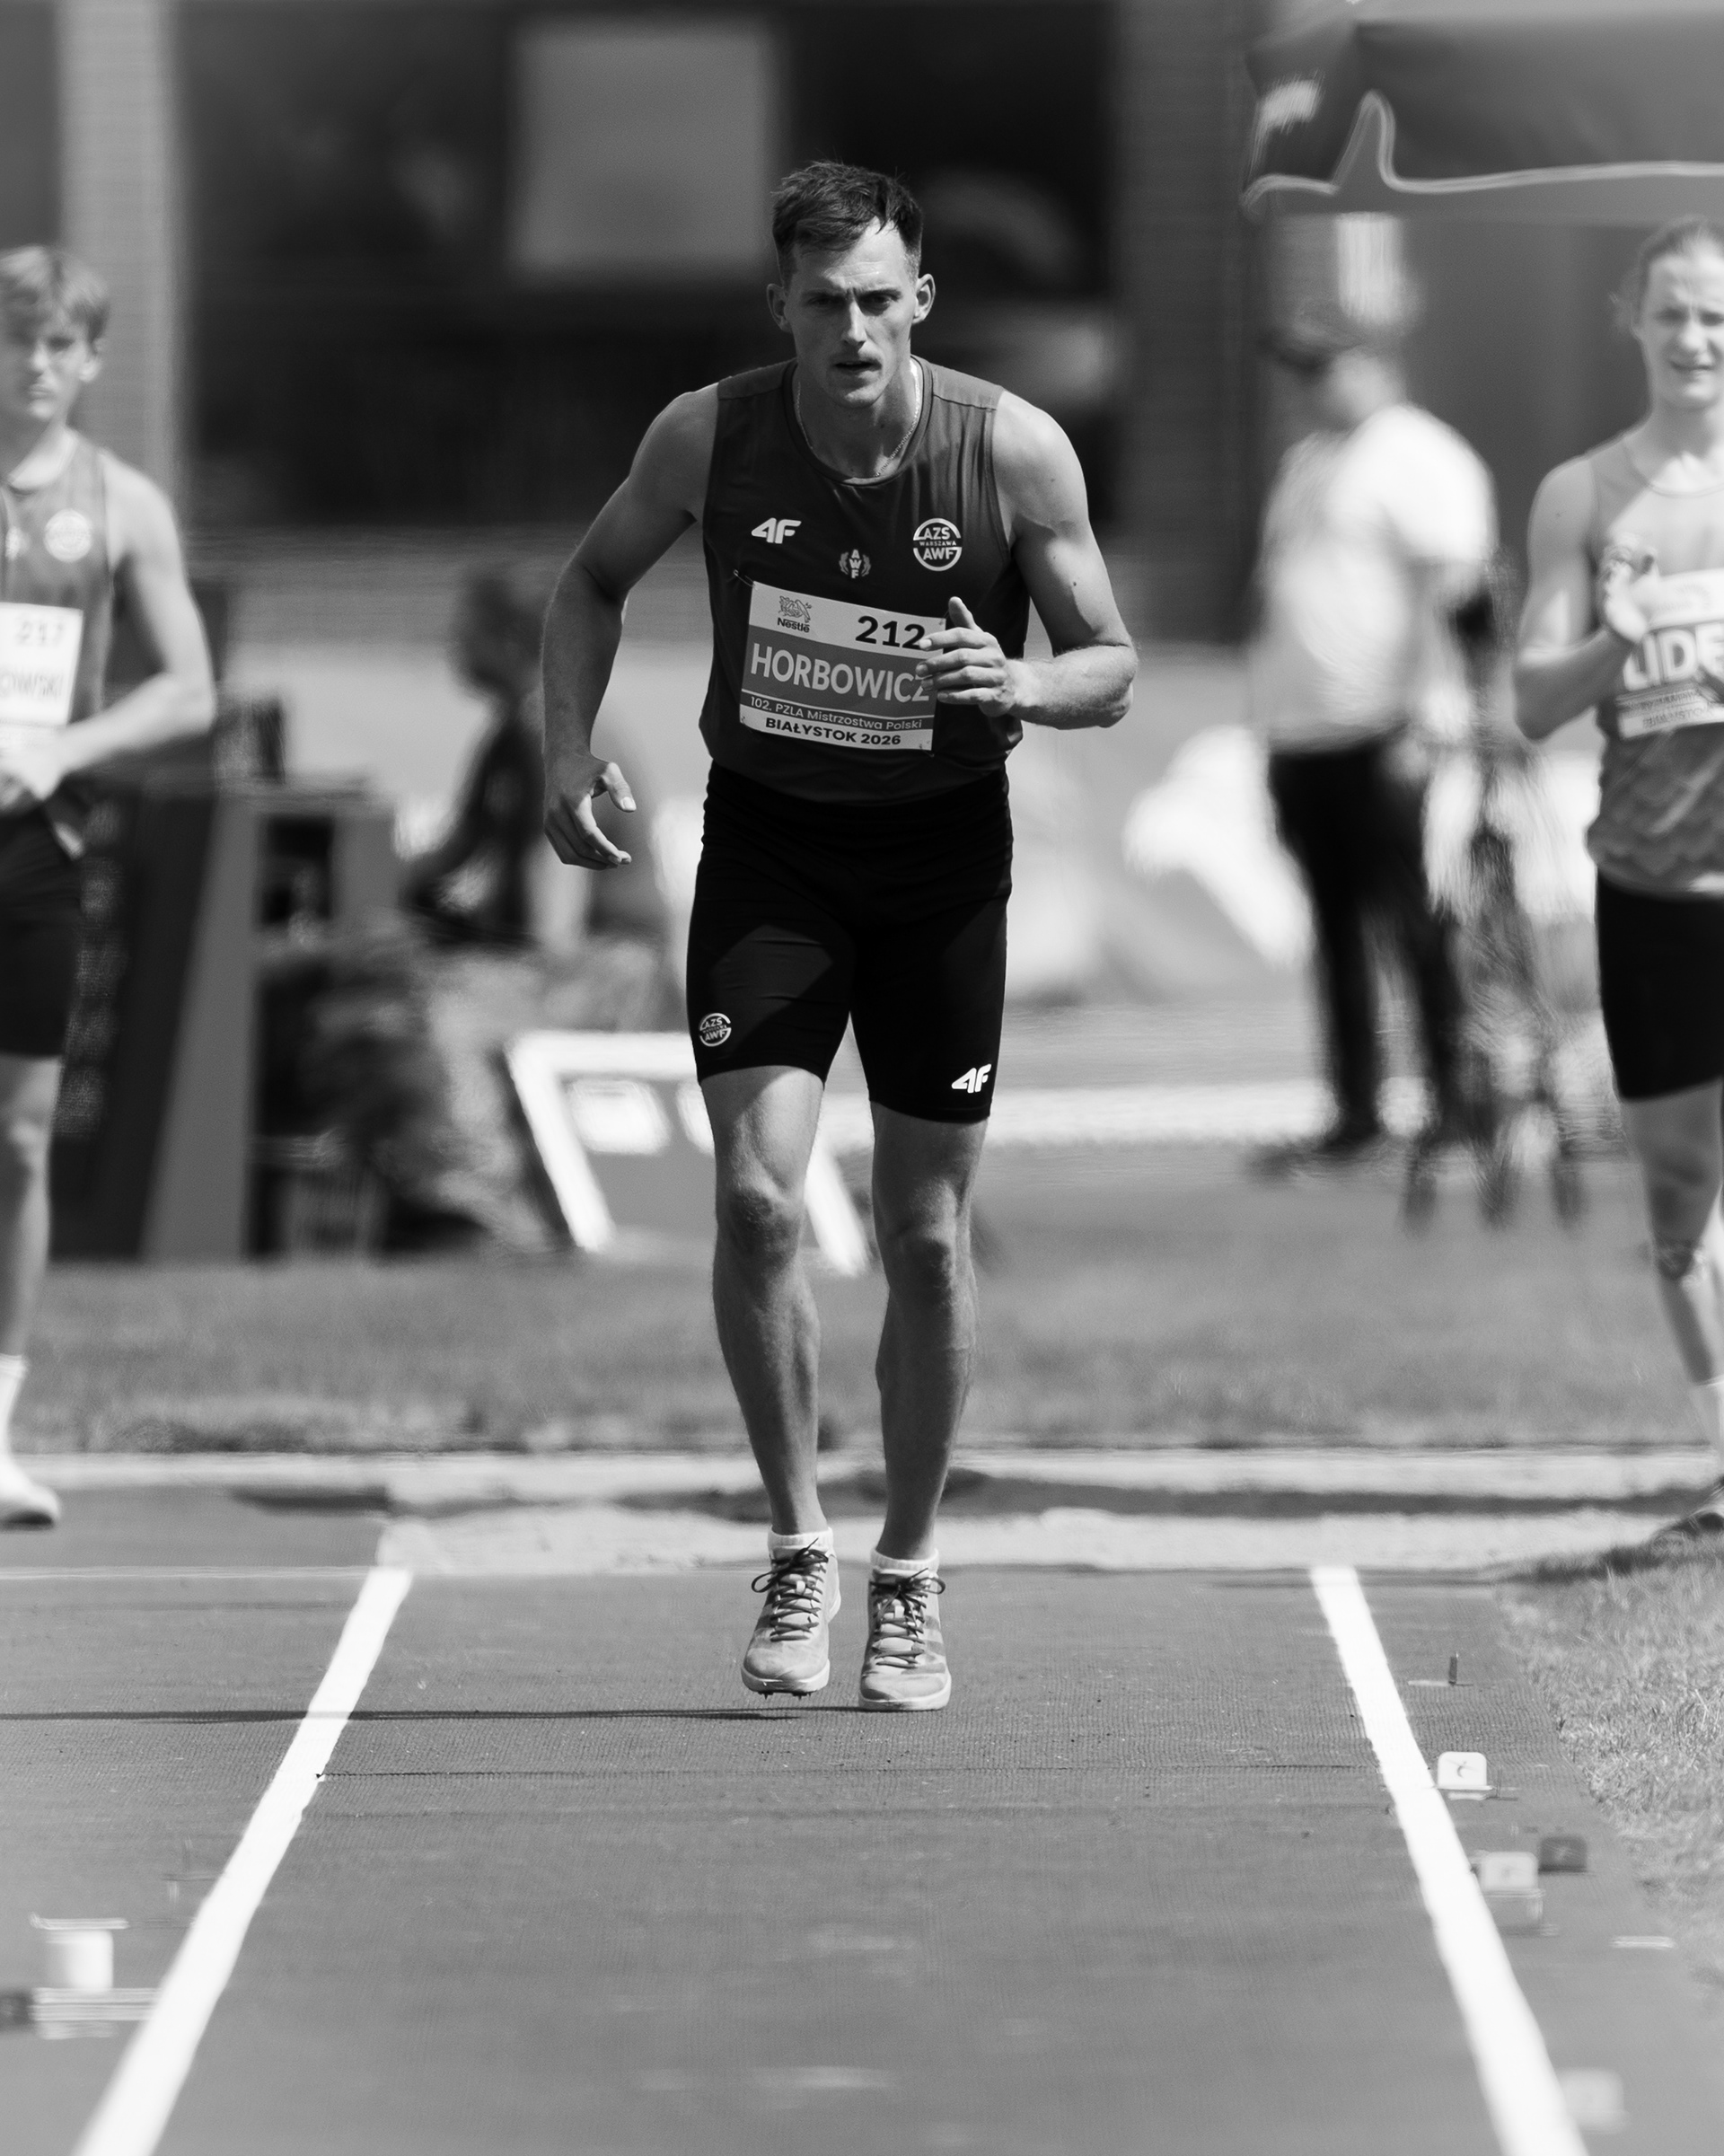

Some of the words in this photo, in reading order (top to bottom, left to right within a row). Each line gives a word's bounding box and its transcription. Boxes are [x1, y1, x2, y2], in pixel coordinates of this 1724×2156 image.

[751, 517, 802, 544] 4F
[923, 526, 951, 540] AZS
[923, 547, 954, 560] AWF
[855, 615, 926, 650] 212
[751, 696, 772, 711] 102.
[775, 703, 805, 718] PZLA
[806, 709, 884, 730] Mistrzostwa
[885, 719, 923, 731] Polski
[765, 717, 858, 744] BIAŁYSTOK
[860, 733, 902, 746] 2026
[705, 1016, 723, 1027] AZS
[951, 1063, 992, 1094] 4F
